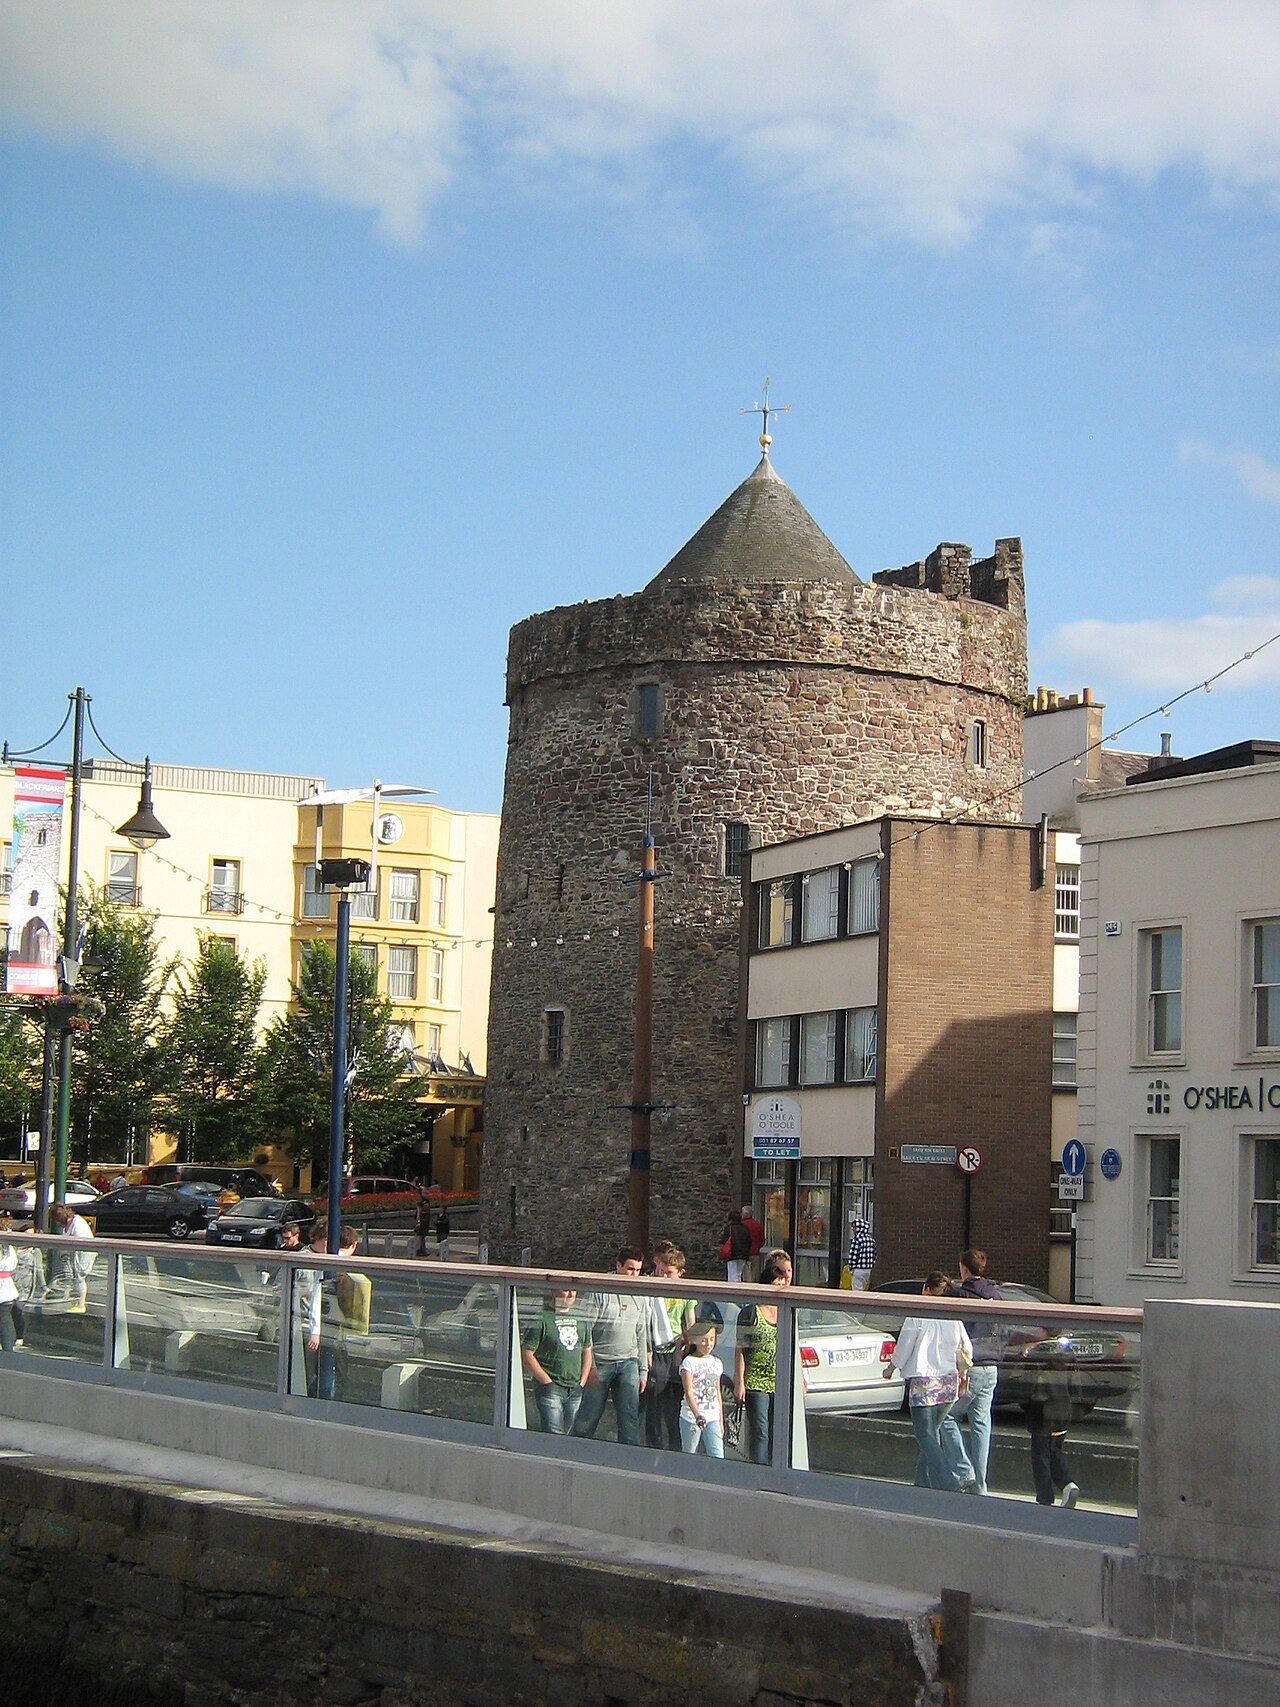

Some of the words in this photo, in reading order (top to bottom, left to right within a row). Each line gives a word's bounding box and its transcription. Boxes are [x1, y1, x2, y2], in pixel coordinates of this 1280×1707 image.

[15, 781, 65, 793] BLACKFRIARS
[1183, 1086, 1253, 1110] O'SHEA
[759, 1113, 795, 1121] O'SHEA
[759, 1121, 795, 1129] O'TOOLE
[1060, 1177, 1082, 1185] ONE-WAY
[1064, 1188, 1077, 1196] ONLY
